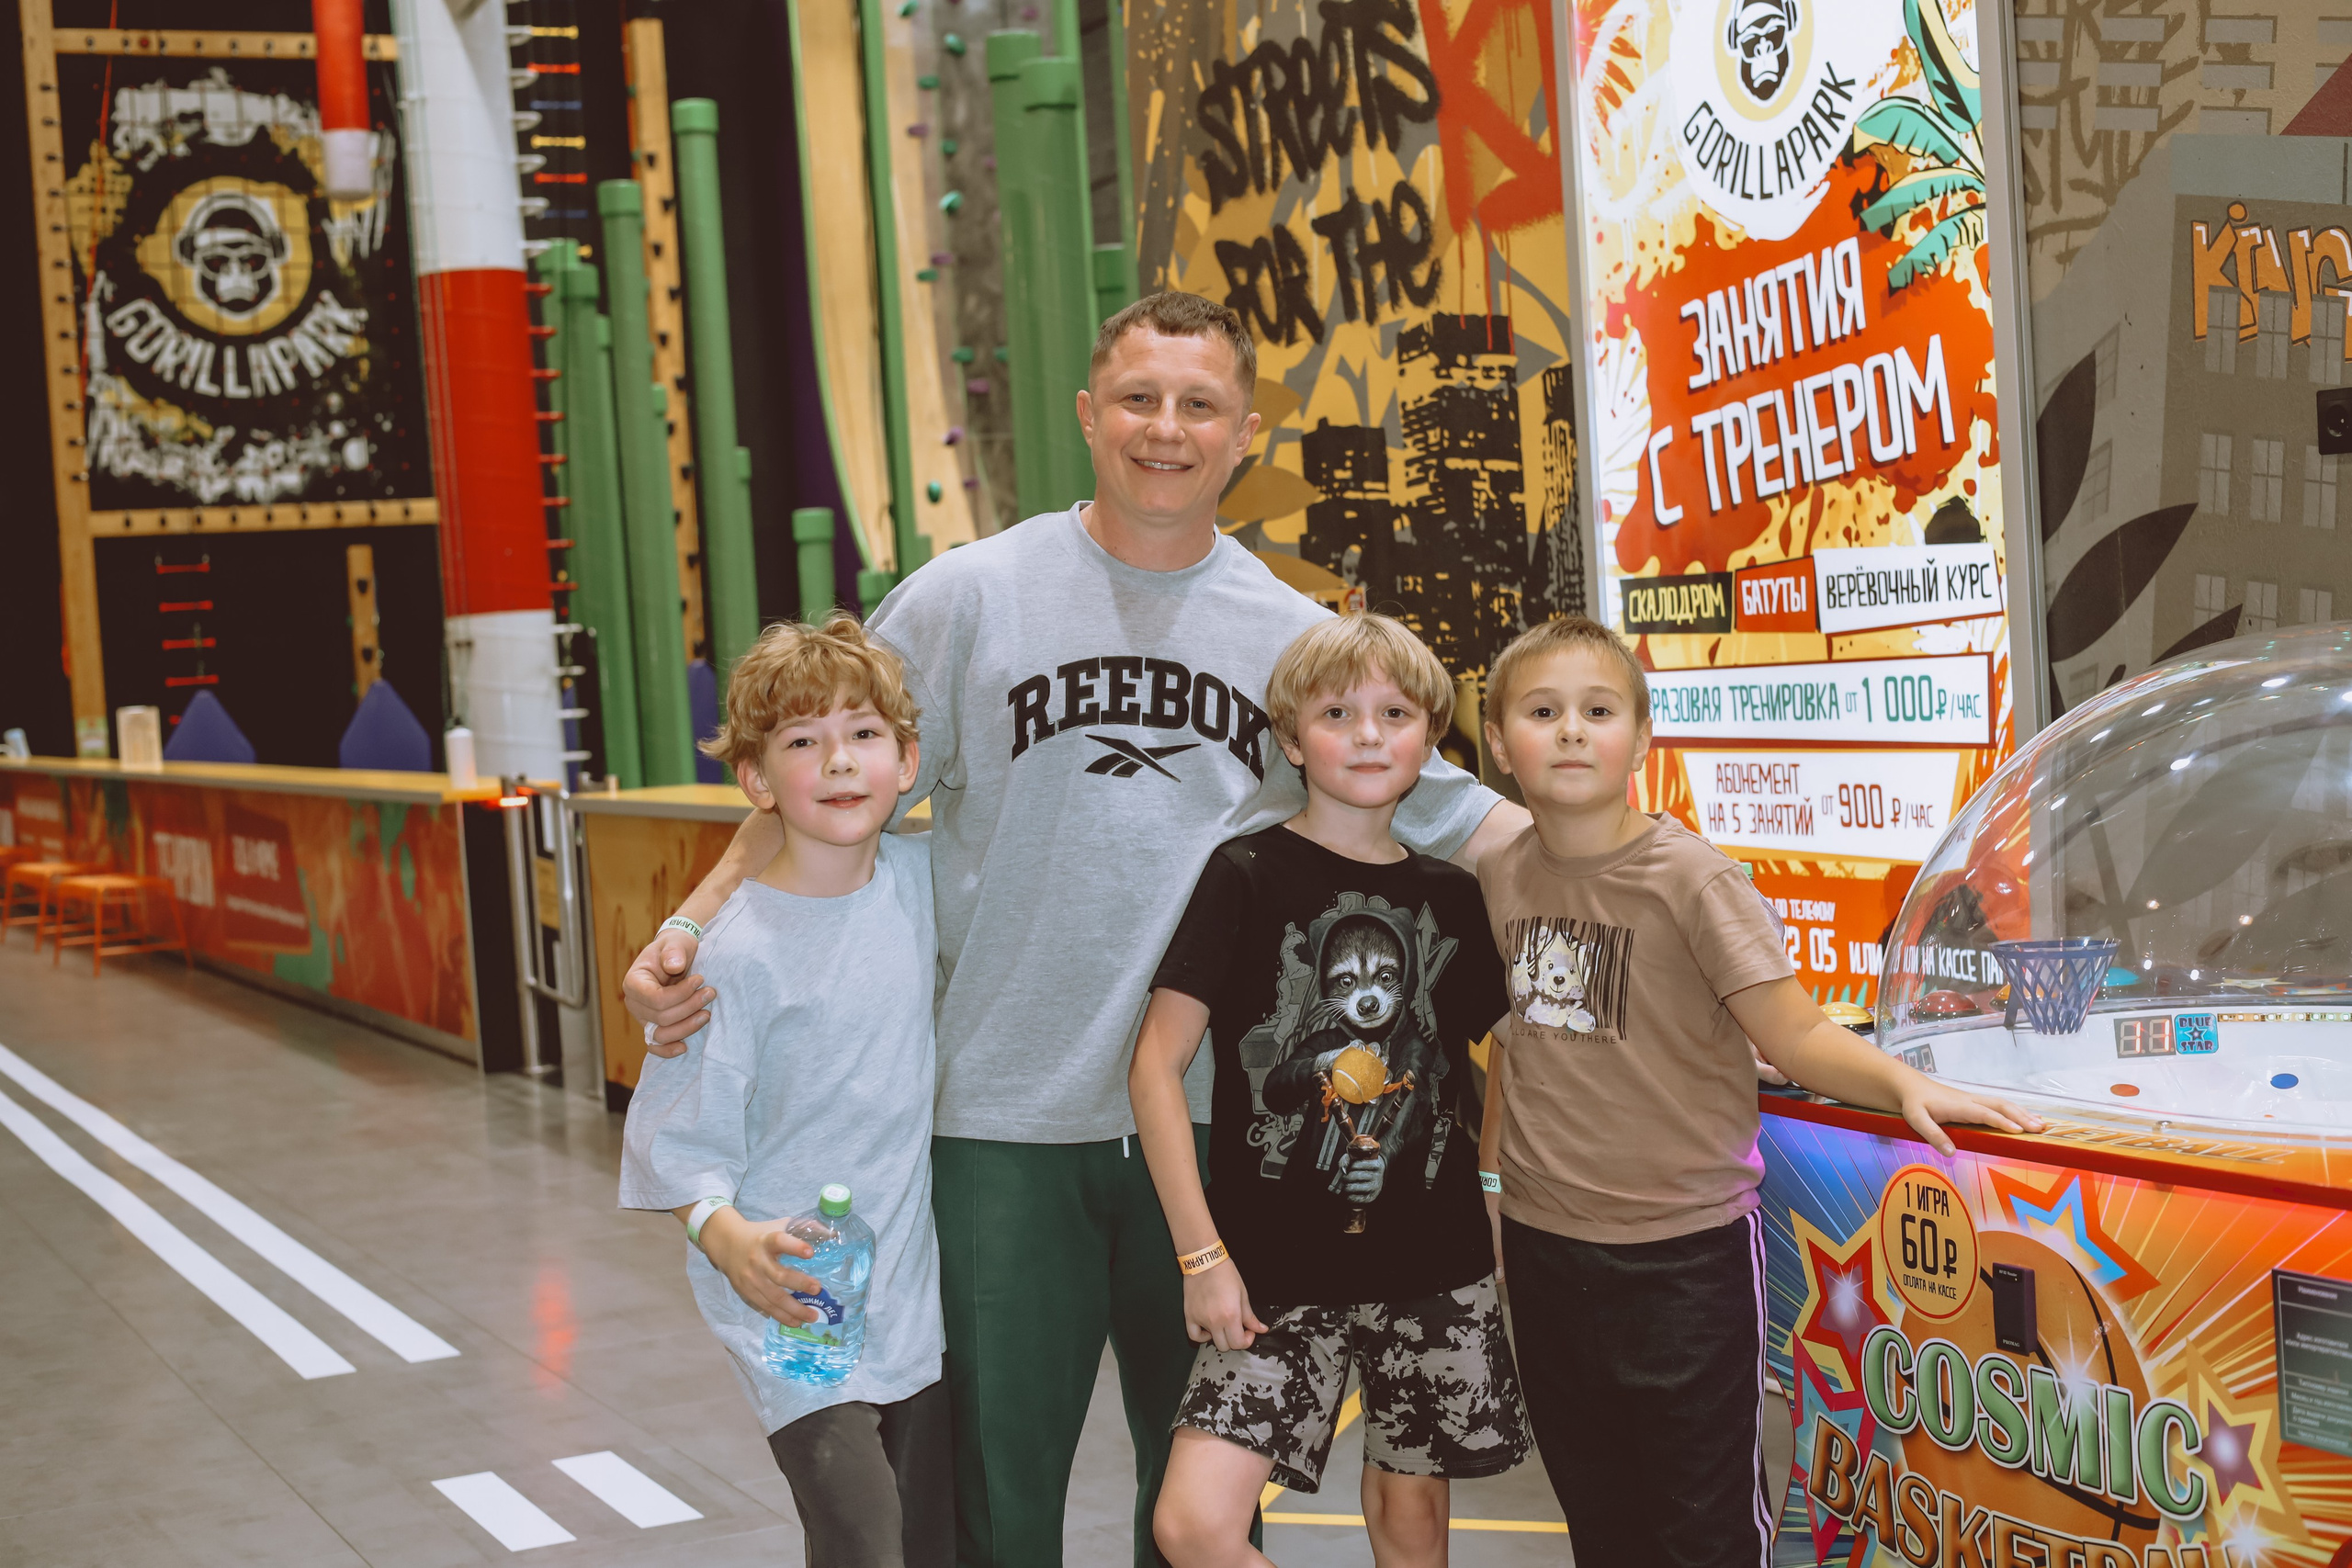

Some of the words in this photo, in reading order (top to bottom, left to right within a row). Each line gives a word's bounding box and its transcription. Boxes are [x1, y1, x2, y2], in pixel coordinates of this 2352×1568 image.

[1683, 61, 1856, 201] GORILLAPARK
[1215, 223, 1324, 347] FOR
[1312, 181, 1443, 327] THE
[1680, 236, 1867, 389] ЗАНЯТИЯ
[106, 290, 368, 399] GORILLAPARK
[1648, 425, 1683, 526] С
[1691, 333, 1956, 512] ТРЕНЕРОМ
[1628, 581, 1726, 624] СКАЛОДРОМ
[1741, 575, 1807, 616] БАТУТЫ
[1826, 558, 1939, 609] ВЕРЁВОЧНЫЙ
[1947, 563, 1992, 601] КУРС
[1008, 655, 1272, 785] REEBOK
[1652, 685, 1721, 723] РАЗОВАЯ
[1728, 682, 1839, 722] ТРЕНИРОВКА
[1845, 692, 1858, 713] ОТ
[1861, 677, 1872, 723] 1
[1716, 762, 1800, 795] АБОНЕМЕНТ
[1708, 802, 1724, 833] НА
[1733, 803, 1741, 833] 5
[1748, 796, 1814, 837] ЗАНЯТИЙ
[1822, 795, 1833, 816] ОТ
[1838, 784, 1884, 829] 900
[1809, 927, 1838, 974] 05
[1849, 941, 1883, 976] ИЛИ
[1939, 946, 1977, 983] КАССЕ
[1528, 1030, 1545, 1040] ARE
[1554, 1032, 1577, 1042] YOU
[1581, 1033, 1617, 1044] THERE
[2178, 1016, 2211, 1028] BLUE
[2180, 1040, 2213, 1052] STAR
[1905, 1181, 1911, 1208] 1
[1917, 1183, 1951, 1218] ИГРА
[1182, 1245, 1226, 1270] GORILLAPARK
[1903, 1273, 1928, 1292] ОПЛАТА
[1928, 1280, 1937, 1295] НА
[1938, 1283, 1958, 1301] КАССЕ
[823, 1305, 838, 1318] ЛЕС
[1863, 1325, 2207, 1520] COSMIC
